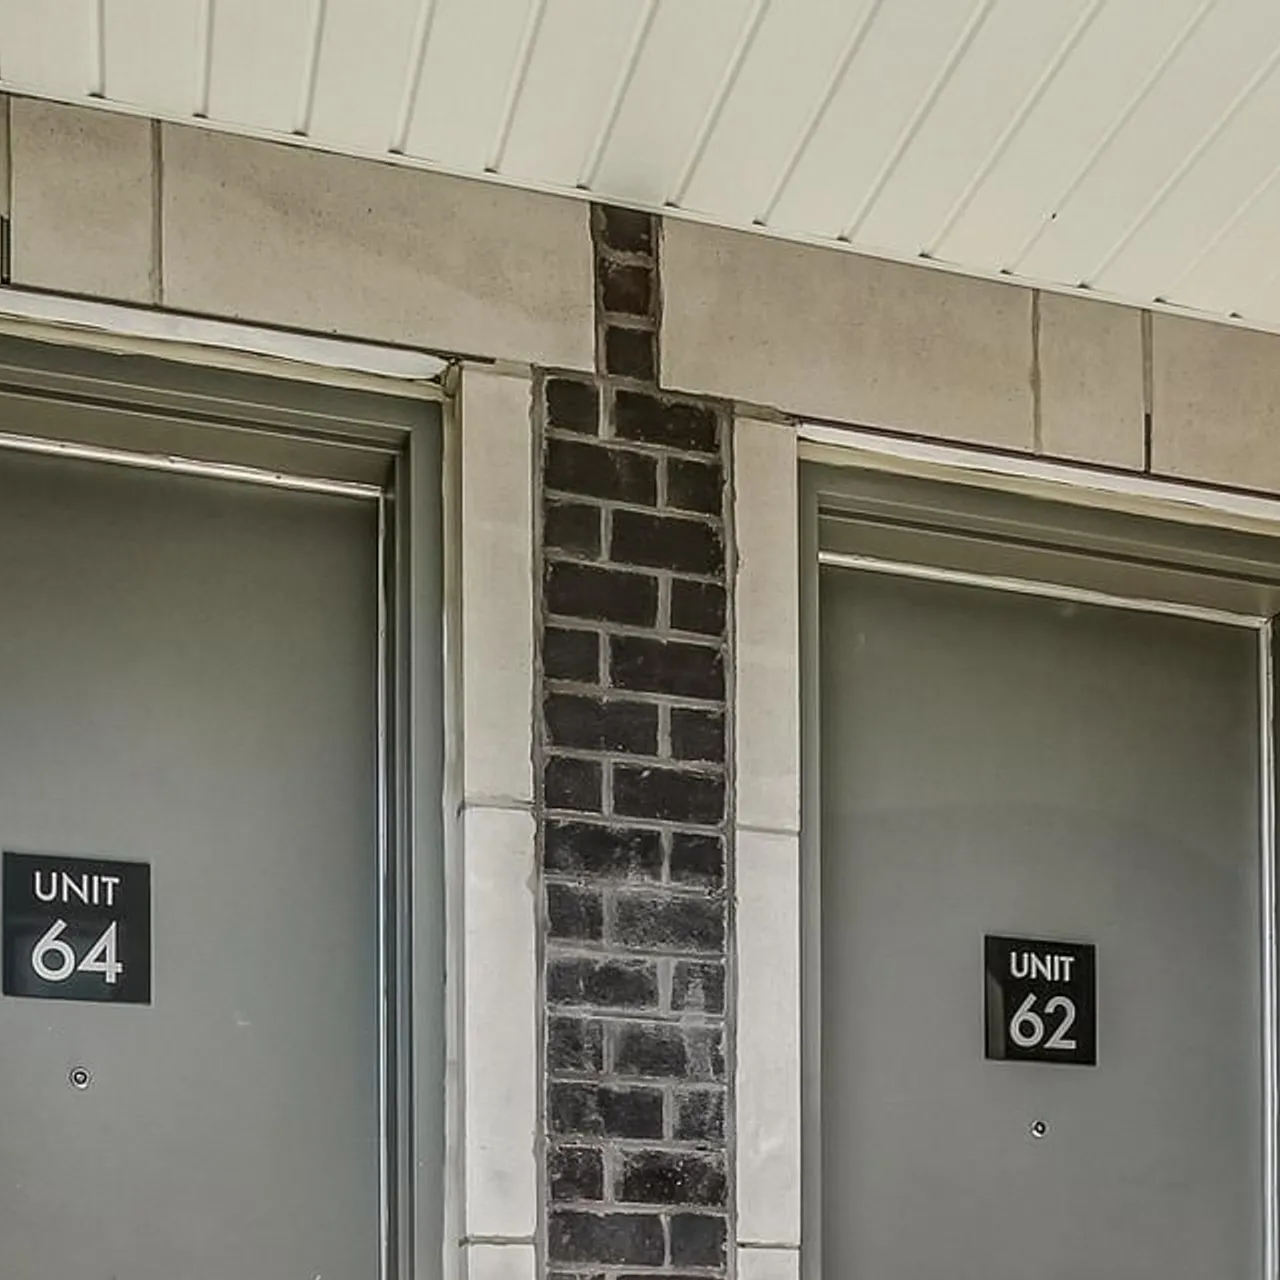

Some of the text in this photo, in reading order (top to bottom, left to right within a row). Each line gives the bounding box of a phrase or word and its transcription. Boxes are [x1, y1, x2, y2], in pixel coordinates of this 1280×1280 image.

[33, 870, 120, 906] UNIT
[32, 919, 123, 984] 64
[1010, 951, 1075, 982] UNIT
[1009, 992, 1077, 1050] 62
